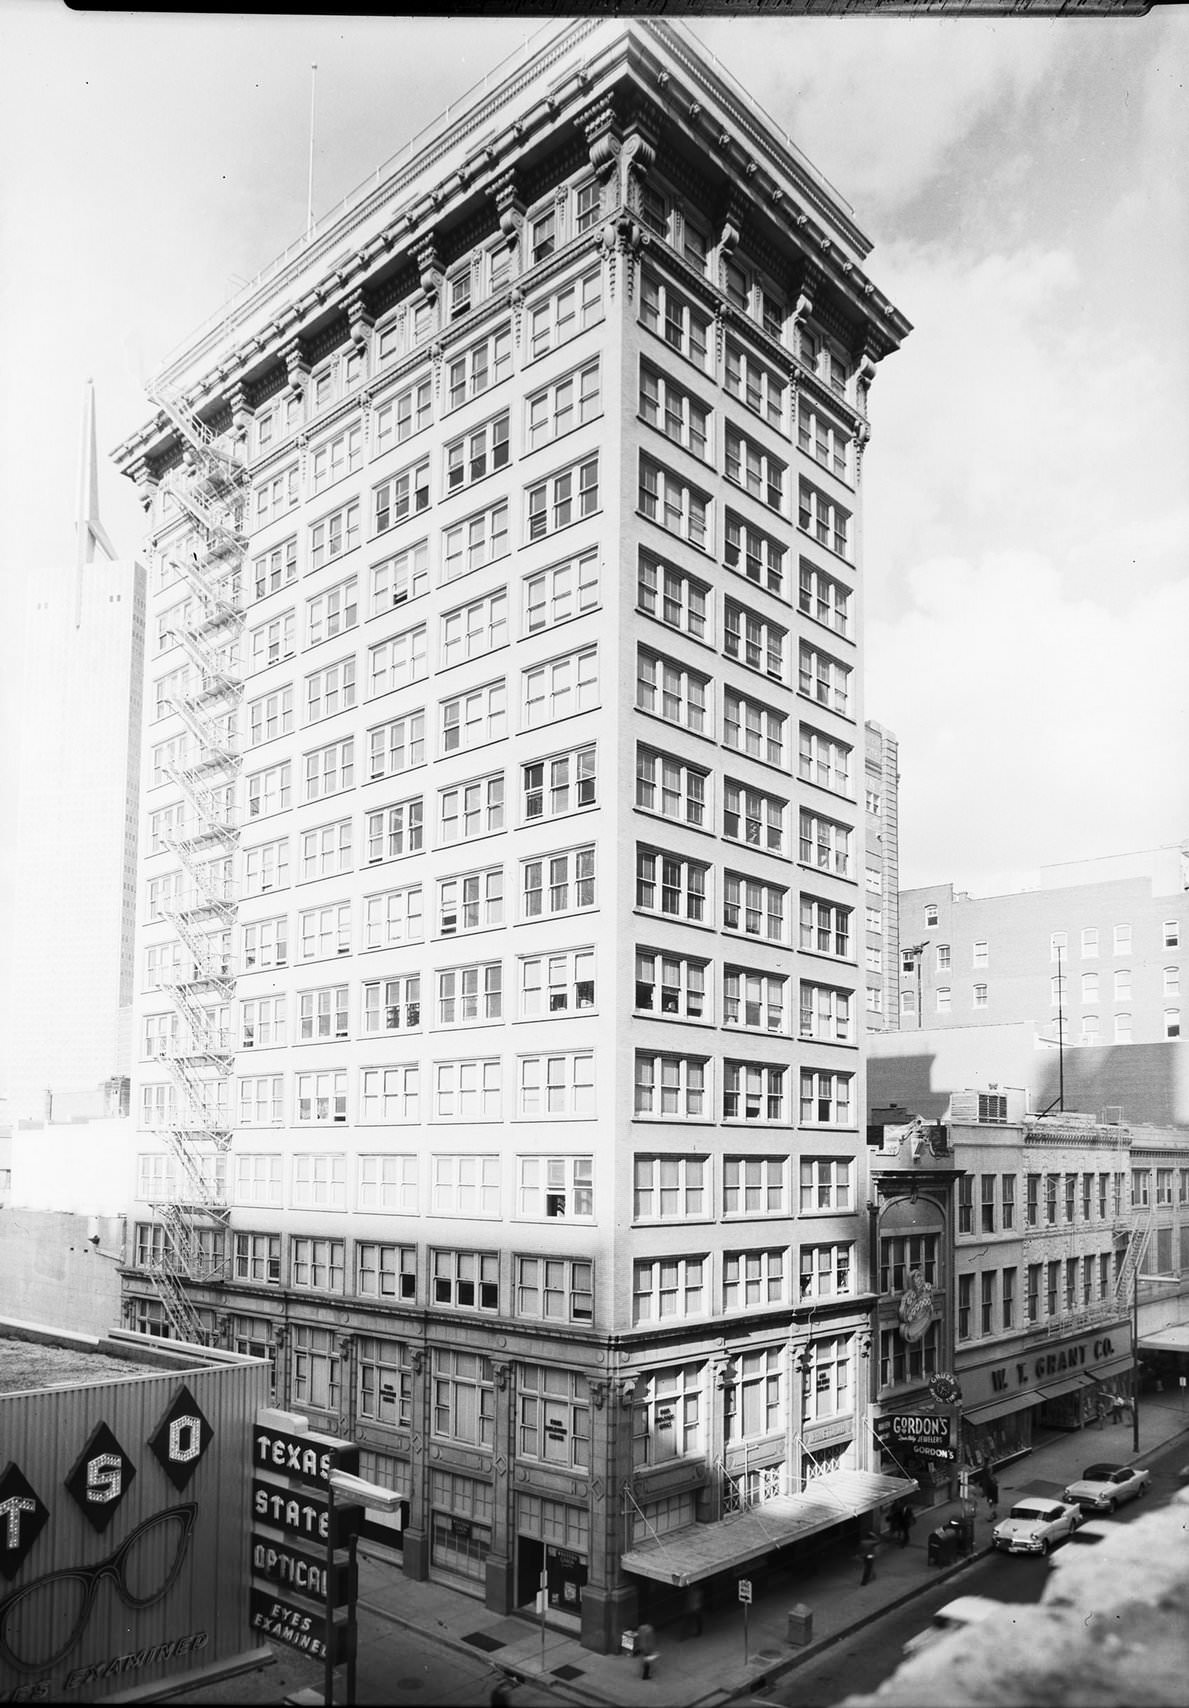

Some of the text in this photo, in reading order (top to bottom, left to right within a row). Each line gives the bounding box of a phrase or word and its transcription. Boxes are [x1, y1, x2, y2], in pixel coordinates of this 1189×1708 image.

[991, 1367, 1008, 1392] W.
[1035, 1343, 1087, 1379] GRANT
[1094, 1337, 1114, 1360] CO.
[893, 1416, 948, 1435] GORDON'S
[256, 1435, 330, 1480] TEXAS
[913, 1445, 955, 1460] GORDON'S
[254, 1489, 329, 1538] STATE
[271, 1603, 312, 1631] EYES
[63, 1631, 209, 1691] EXAMINED
